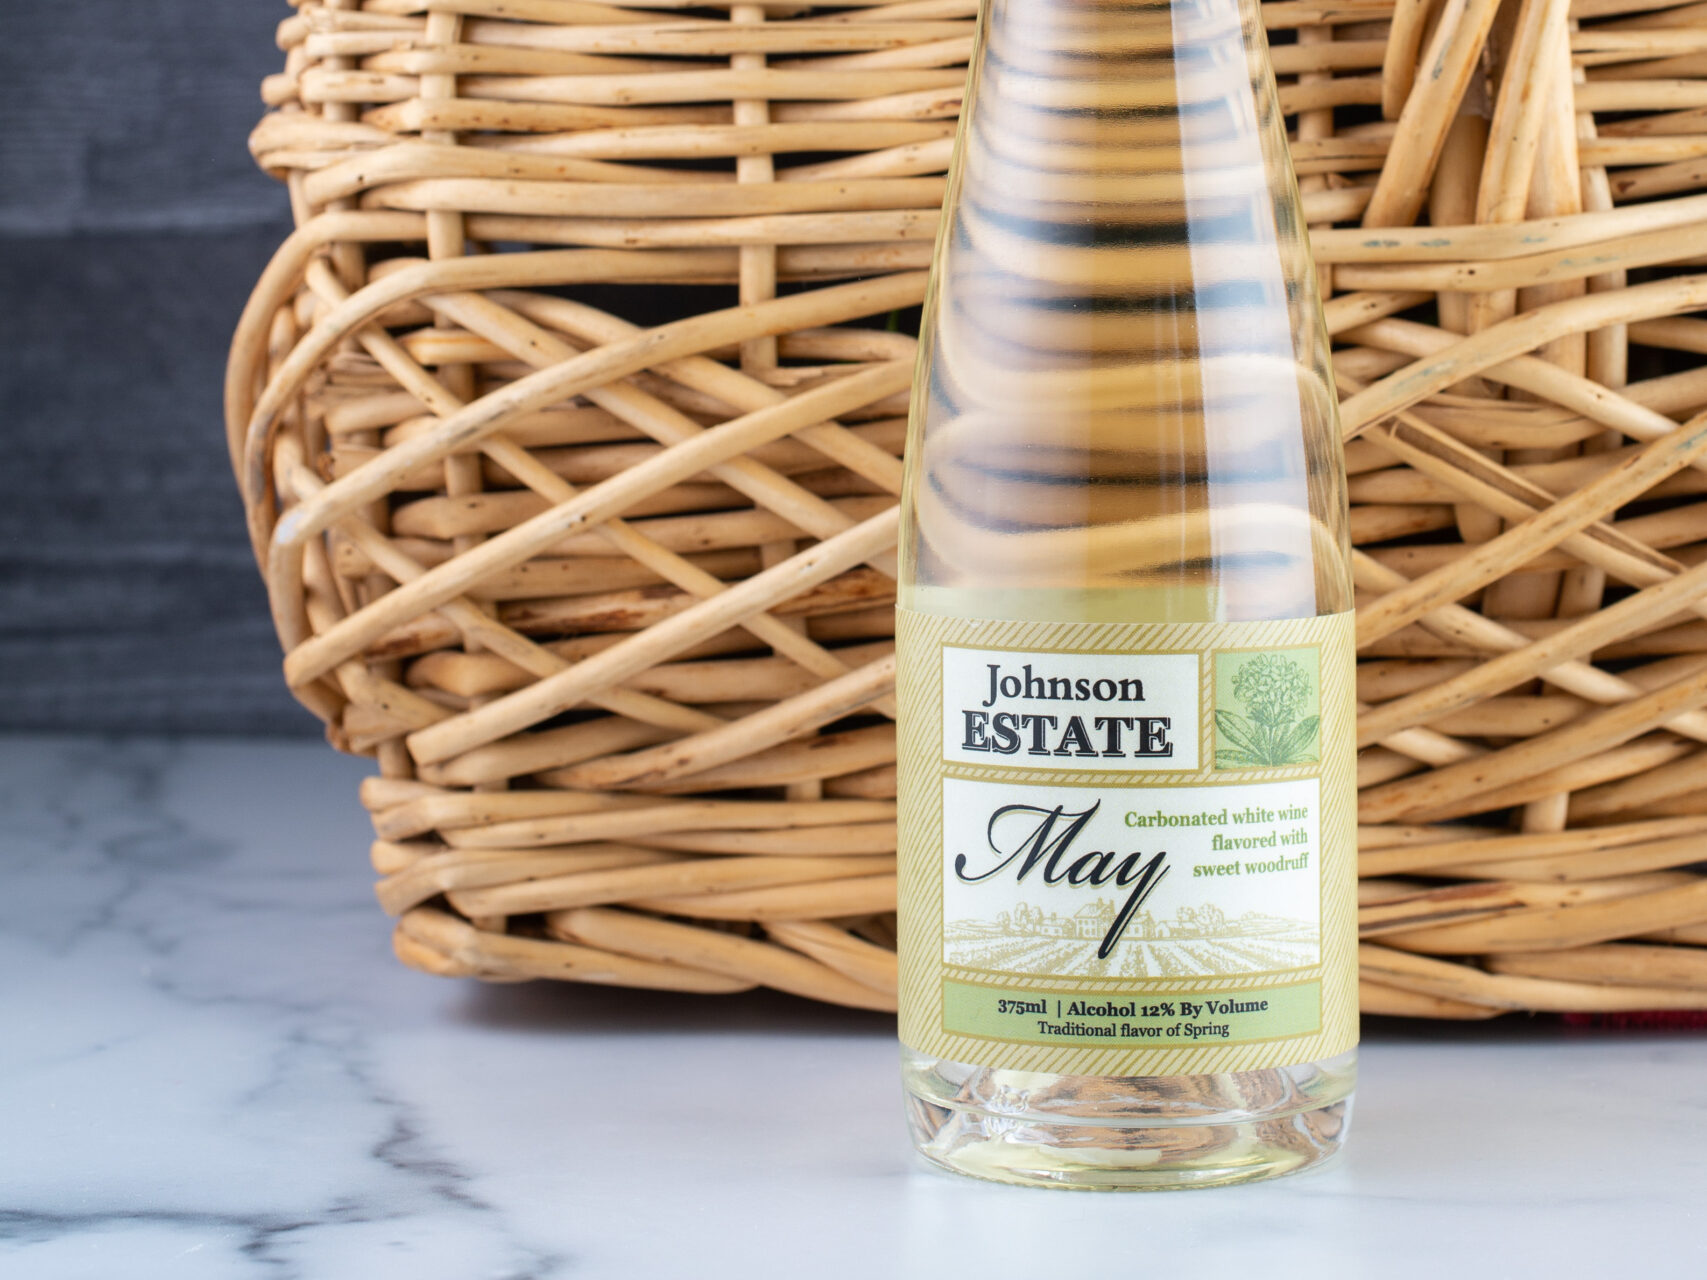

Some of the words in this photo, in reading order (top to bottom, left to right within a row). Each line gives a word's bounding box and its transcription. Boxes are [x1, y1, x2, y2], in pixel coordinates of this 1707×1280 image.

[982, 664, 1146, 707] Johnson
[961, 710, 1174, 758] ESTATE
[1124, 809, 1229, 828] Carbonated
[1232, 806, 1275, 825] white
[1278, 803, 1309, 821] wine
[1211, 830, 1277, 851] flavored
[1280, 827, 1309, 847] with
[1192, 859, 1241, 878] sweet
[1244, 852, 1310, 875] woodruff
[954, 798, 1171, 960] May
[998, 998, 1048, 1015] 375ml
[1066, 1000, 1137, 1018] Alcohol
[1140, 1003, 1176, 1017] 12%
[1179, 1001, 1204, 1020] By
[1205, 998, 1269, 1016] Volume
[1037, 1020, 1117, 1038] Traditional
[1119, 1022, 1164, 1038] flavor
[1165, 1022, 1183, 1038] of
[1183, 1022, 1231, 1041] Spring
